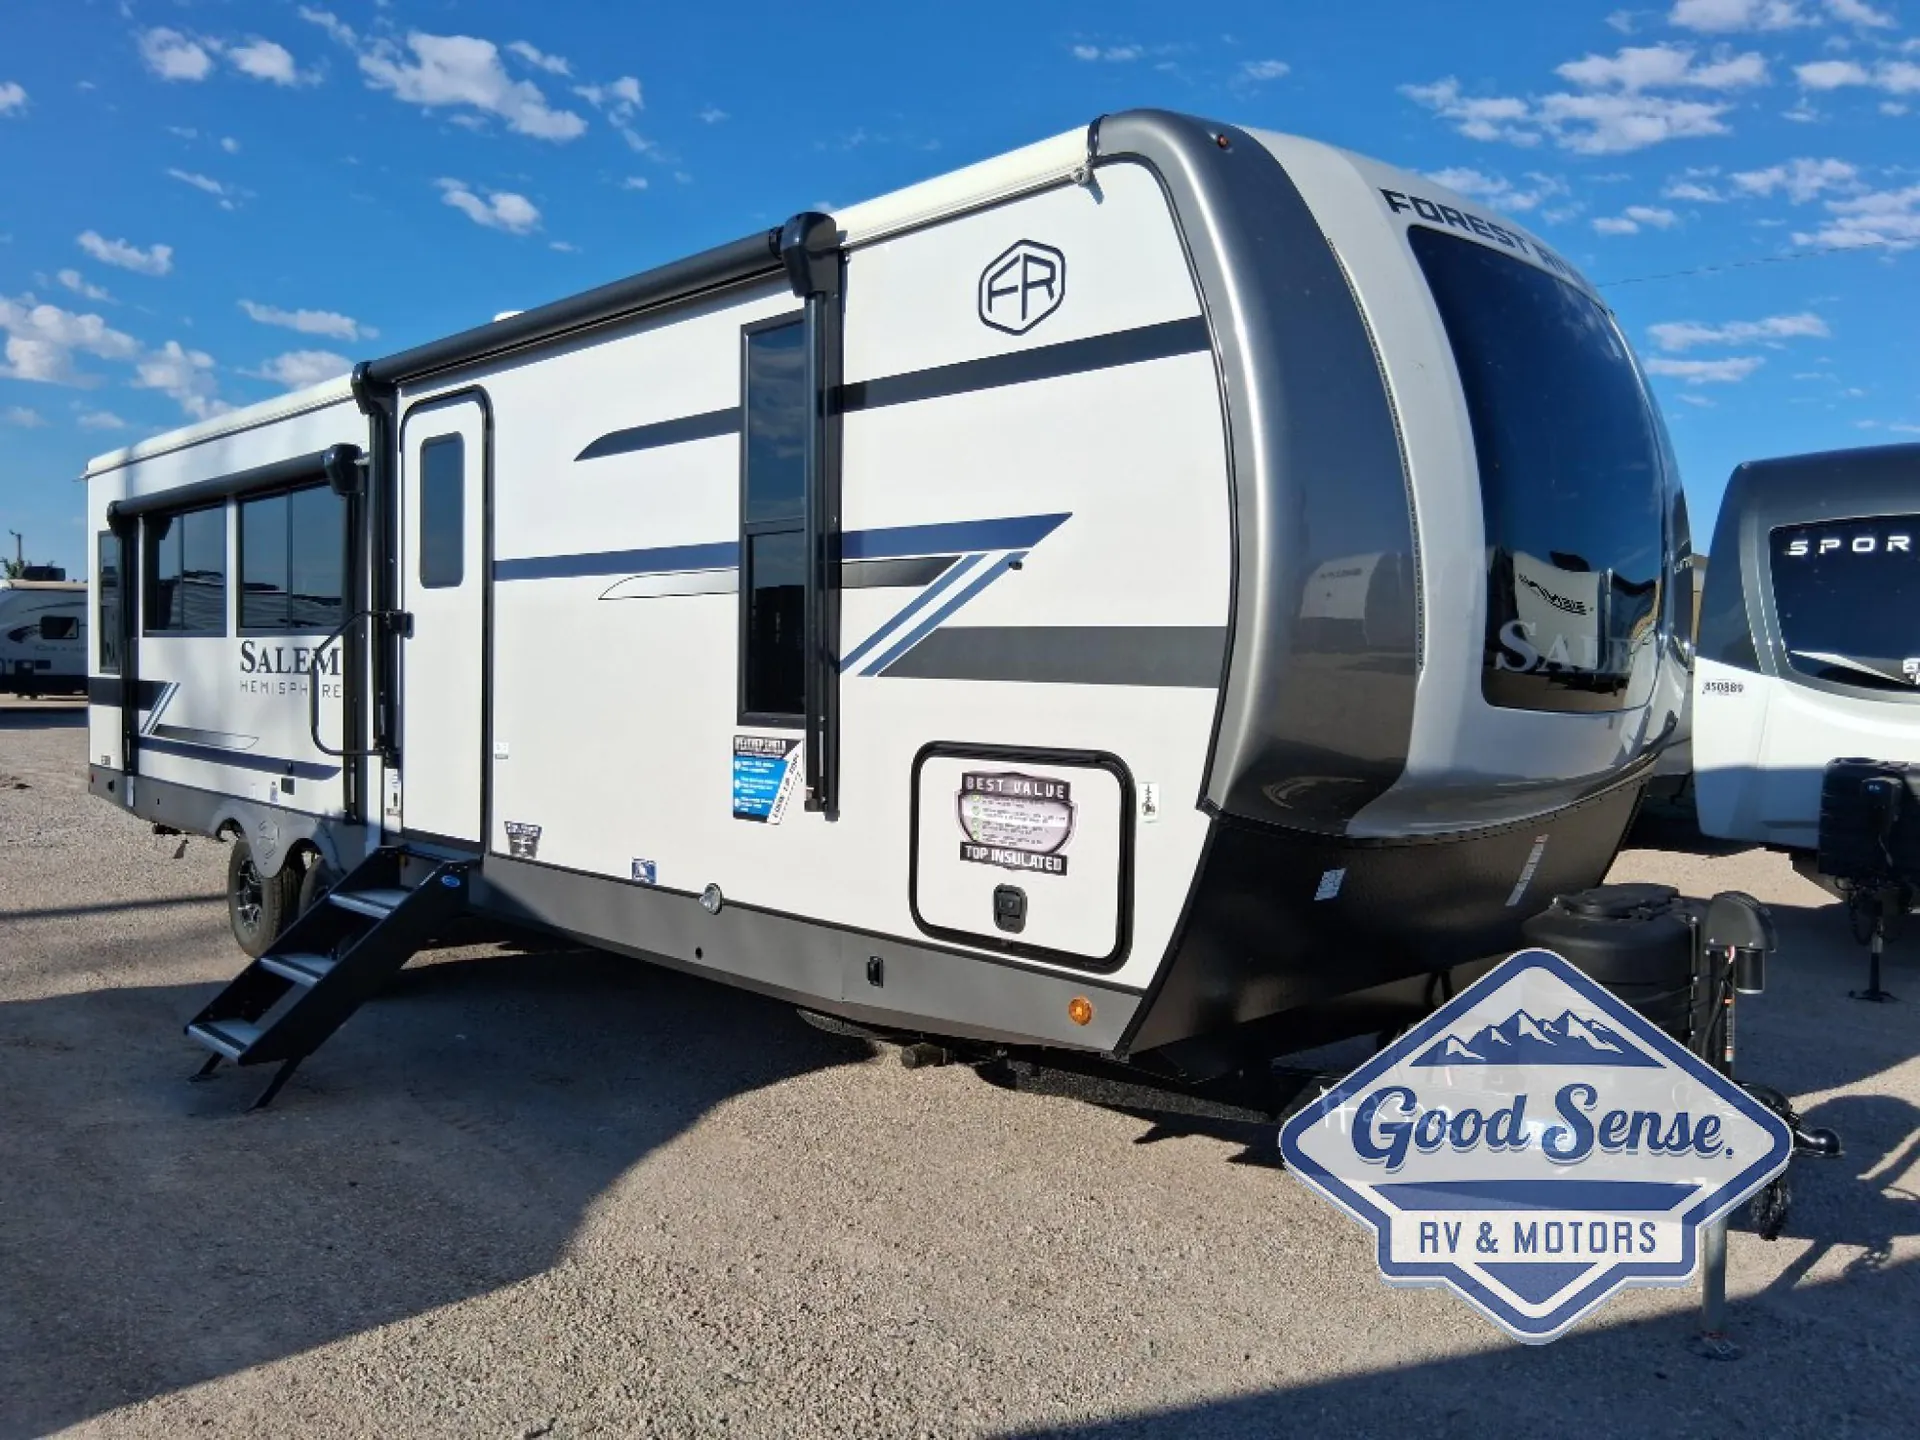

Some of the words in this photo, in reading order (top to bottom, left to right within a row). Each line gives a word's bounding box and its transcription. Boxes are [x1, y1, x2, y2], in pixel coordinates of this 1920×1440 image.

[1377, 186, 1530, 256] FOREST
[986, 251, 1057, 322] FR
[240, 640, 342, 676] SALEM
[239, 680, 342, 699] HEMISPHRE
[965, 775, 1004, 792] BEST
[1013, 780, 1066, 800] VALUE
[965, 845, 989, 861] TOP
[991, 848, 1063, 872] INSULATED
